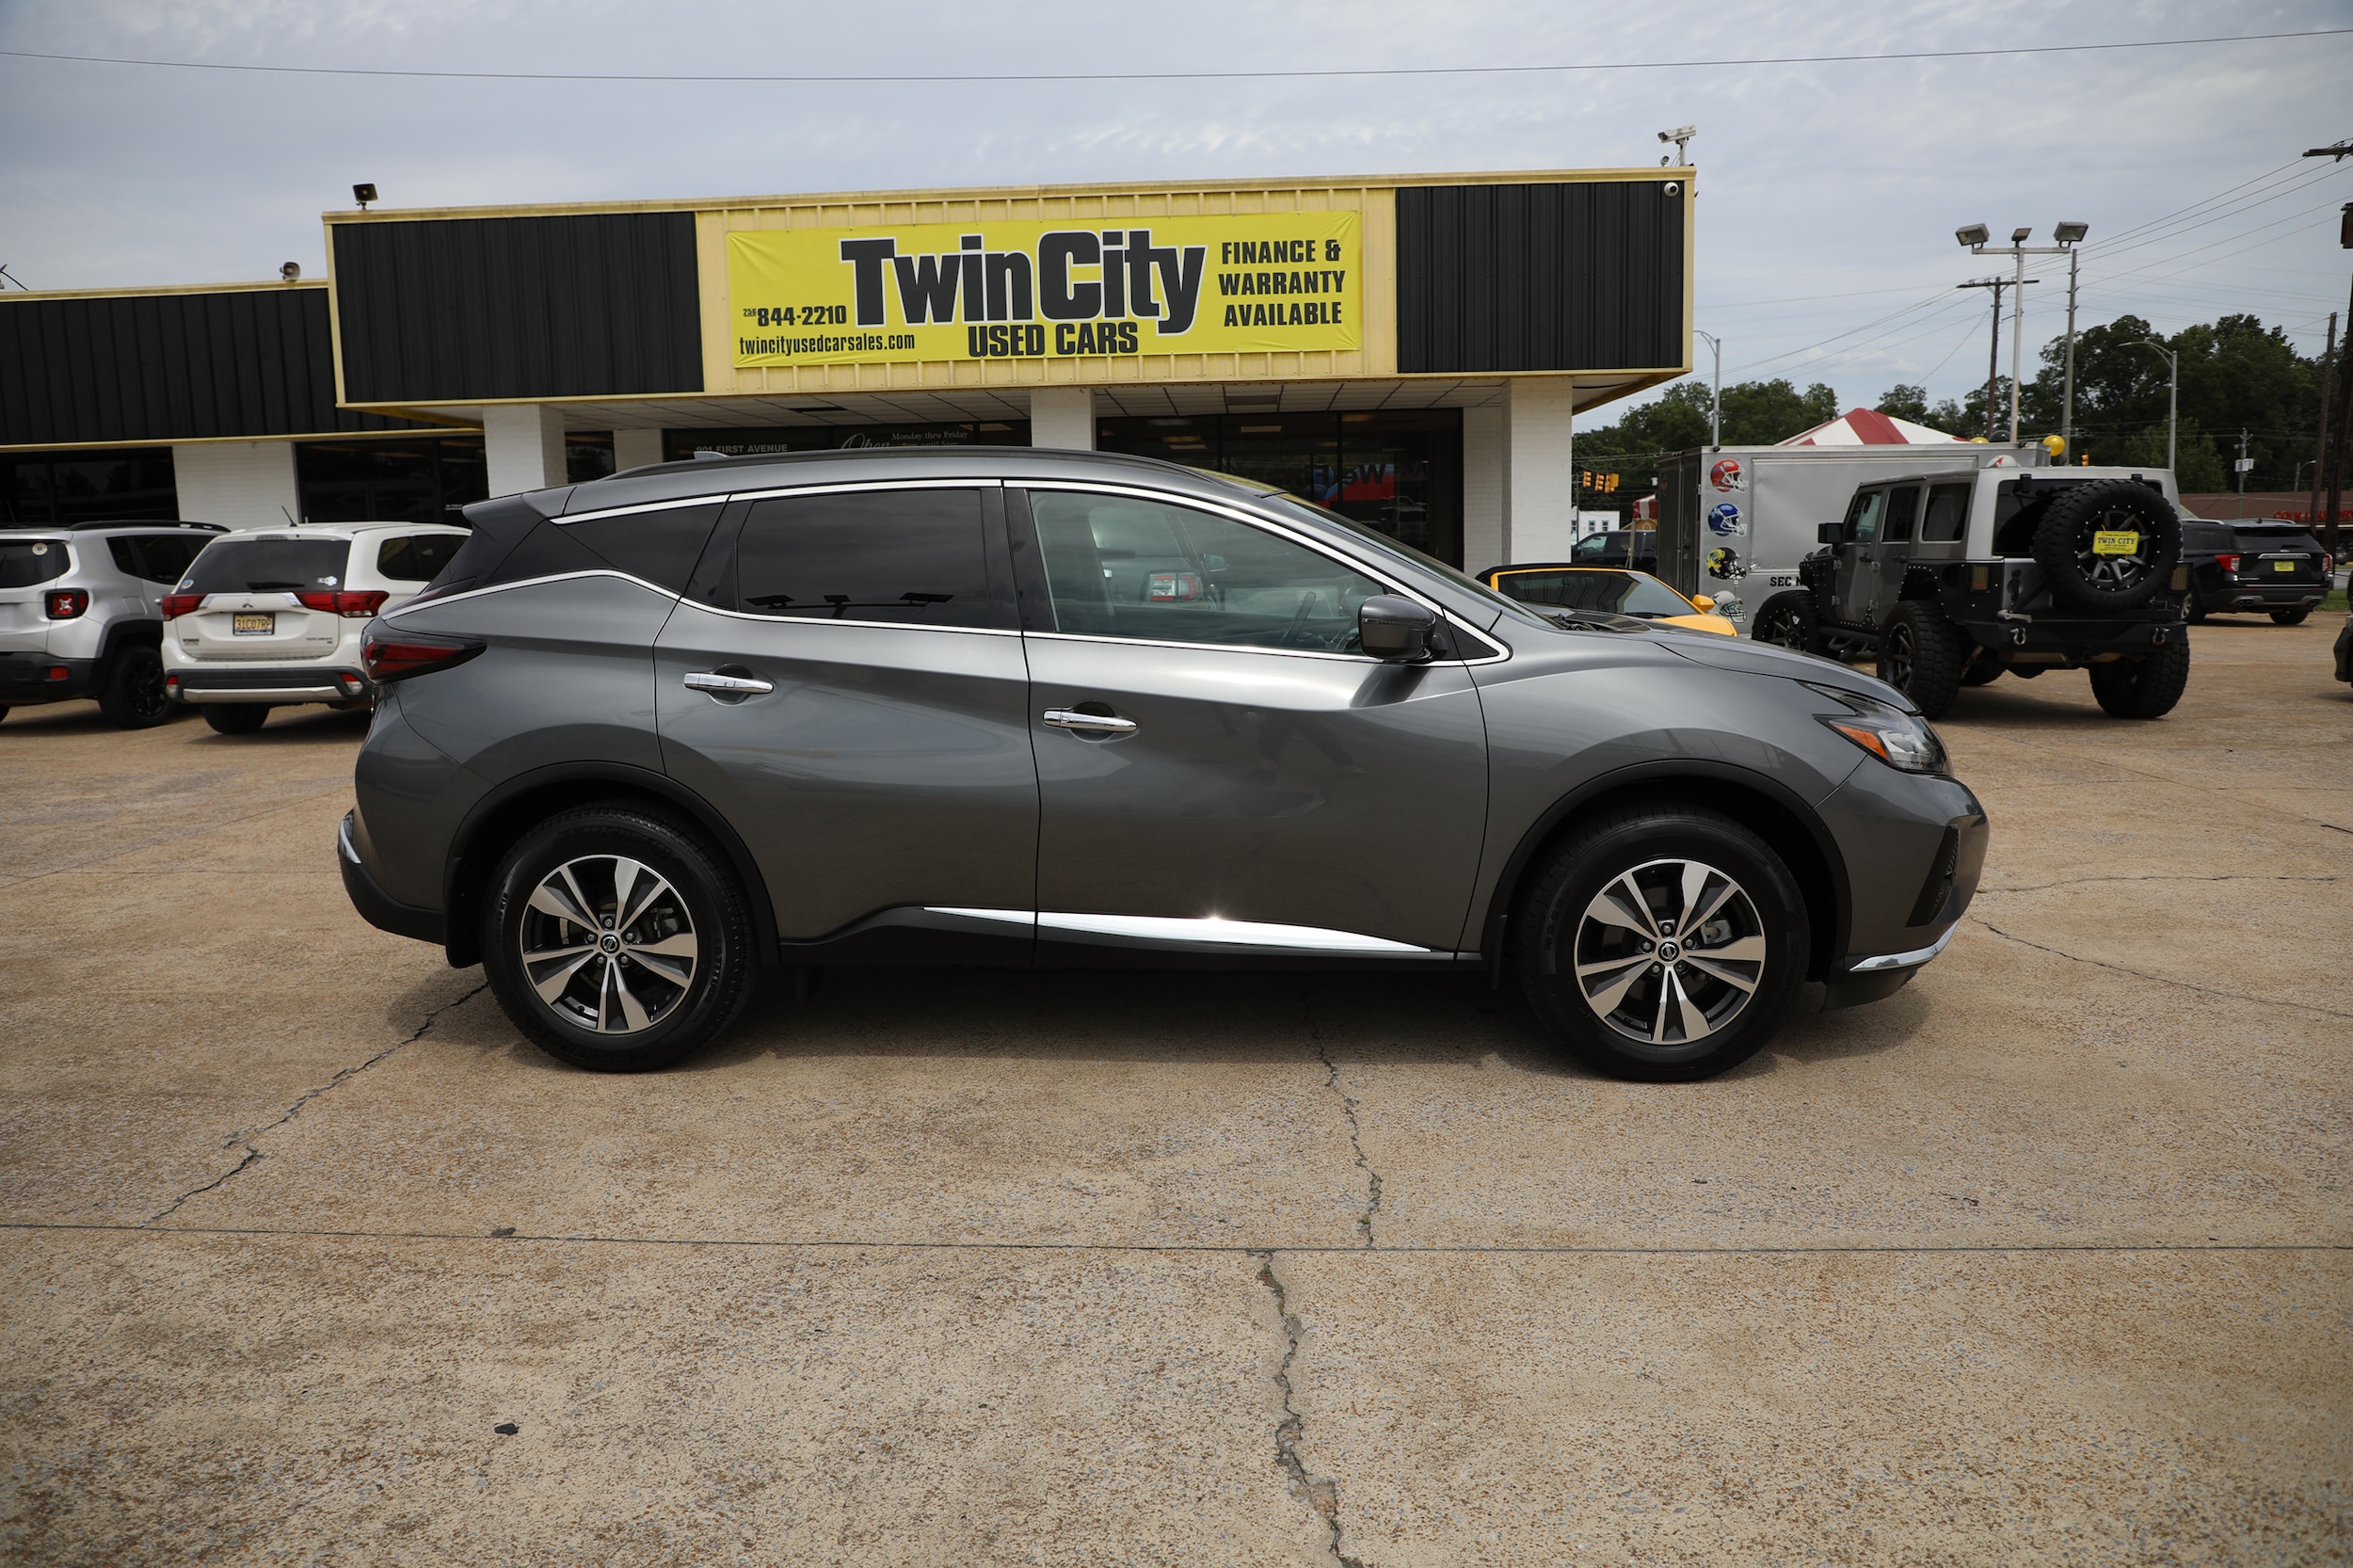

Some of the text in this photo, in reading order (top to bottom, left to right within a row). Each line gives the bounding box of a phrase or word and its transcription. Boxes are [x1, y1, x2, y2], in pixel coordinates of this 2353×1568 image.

[1222, 239, 1341, 264] FINANCE &
[1218, 270, 1346, 296] WARRANTY
[757, 305, 847, 327] 844-2210
[1224, 301, 1342, 327] AVAILABLE
[740, 333, 915, 356] twincityusedcarsales.com
[968, 321, 1138, 358] USED CARS
[891, 433, 922, 441] Monday
[944, 431, 968, 440] Friday
[716, 445, 744, 454] FIRST
[747, 443, 789, 453] AVENUE
[1769, 576, 1792, 586] SEC
